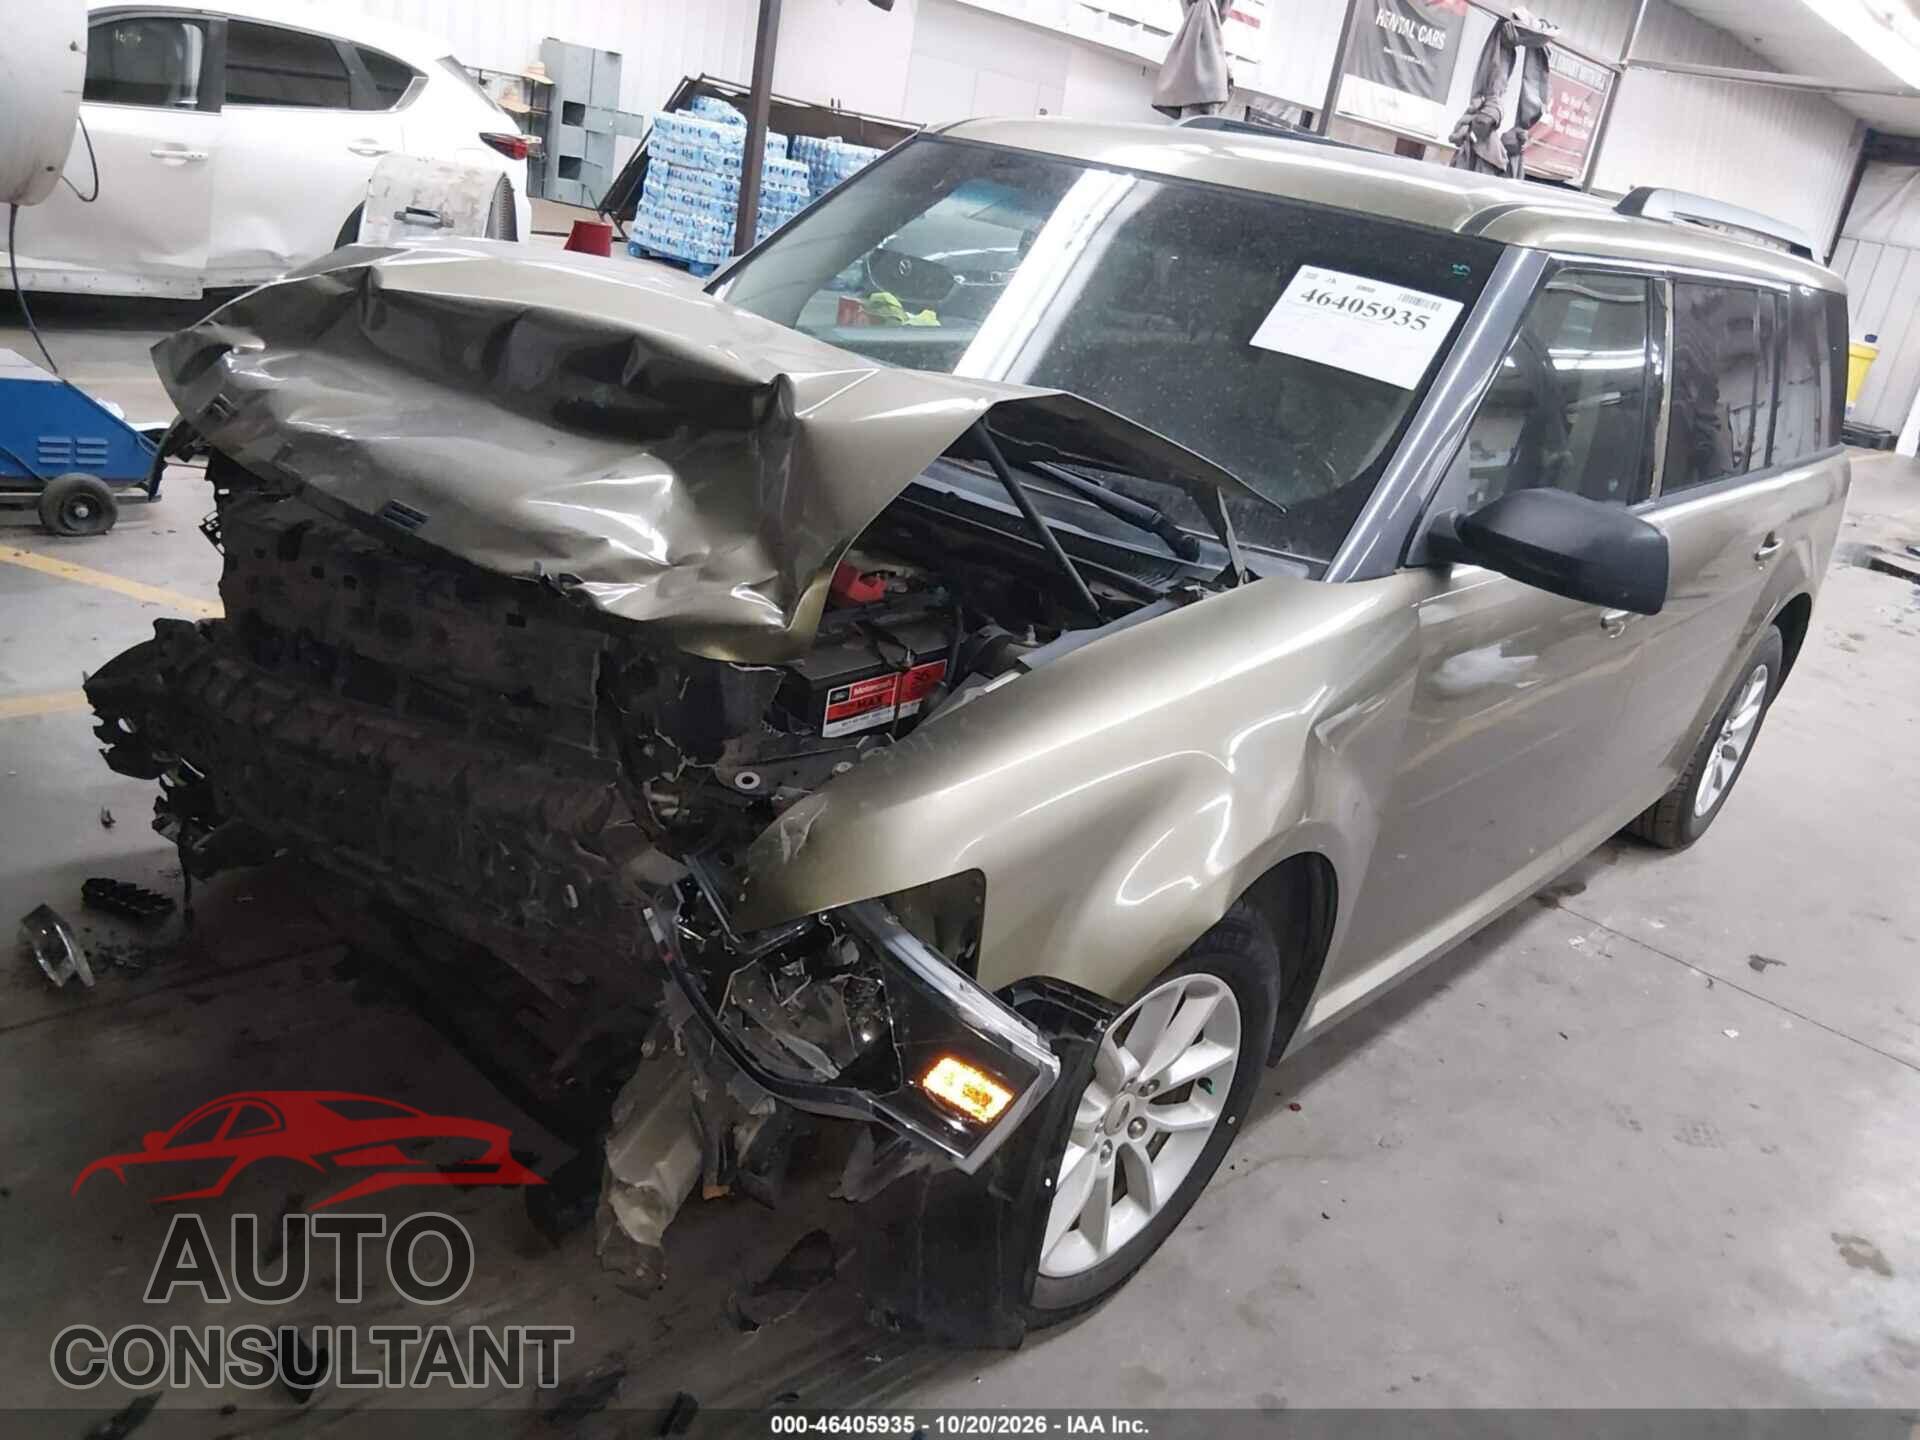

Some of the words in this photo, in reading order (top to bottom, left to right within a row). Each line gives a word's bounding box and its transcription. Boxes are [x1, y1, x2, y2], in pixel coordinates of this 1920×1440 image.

[1376, 8, 1417, 39] RENTAL
[1418, 25, 1447, 50] CARS
[1301, 288, 1431, 331] 46405935
